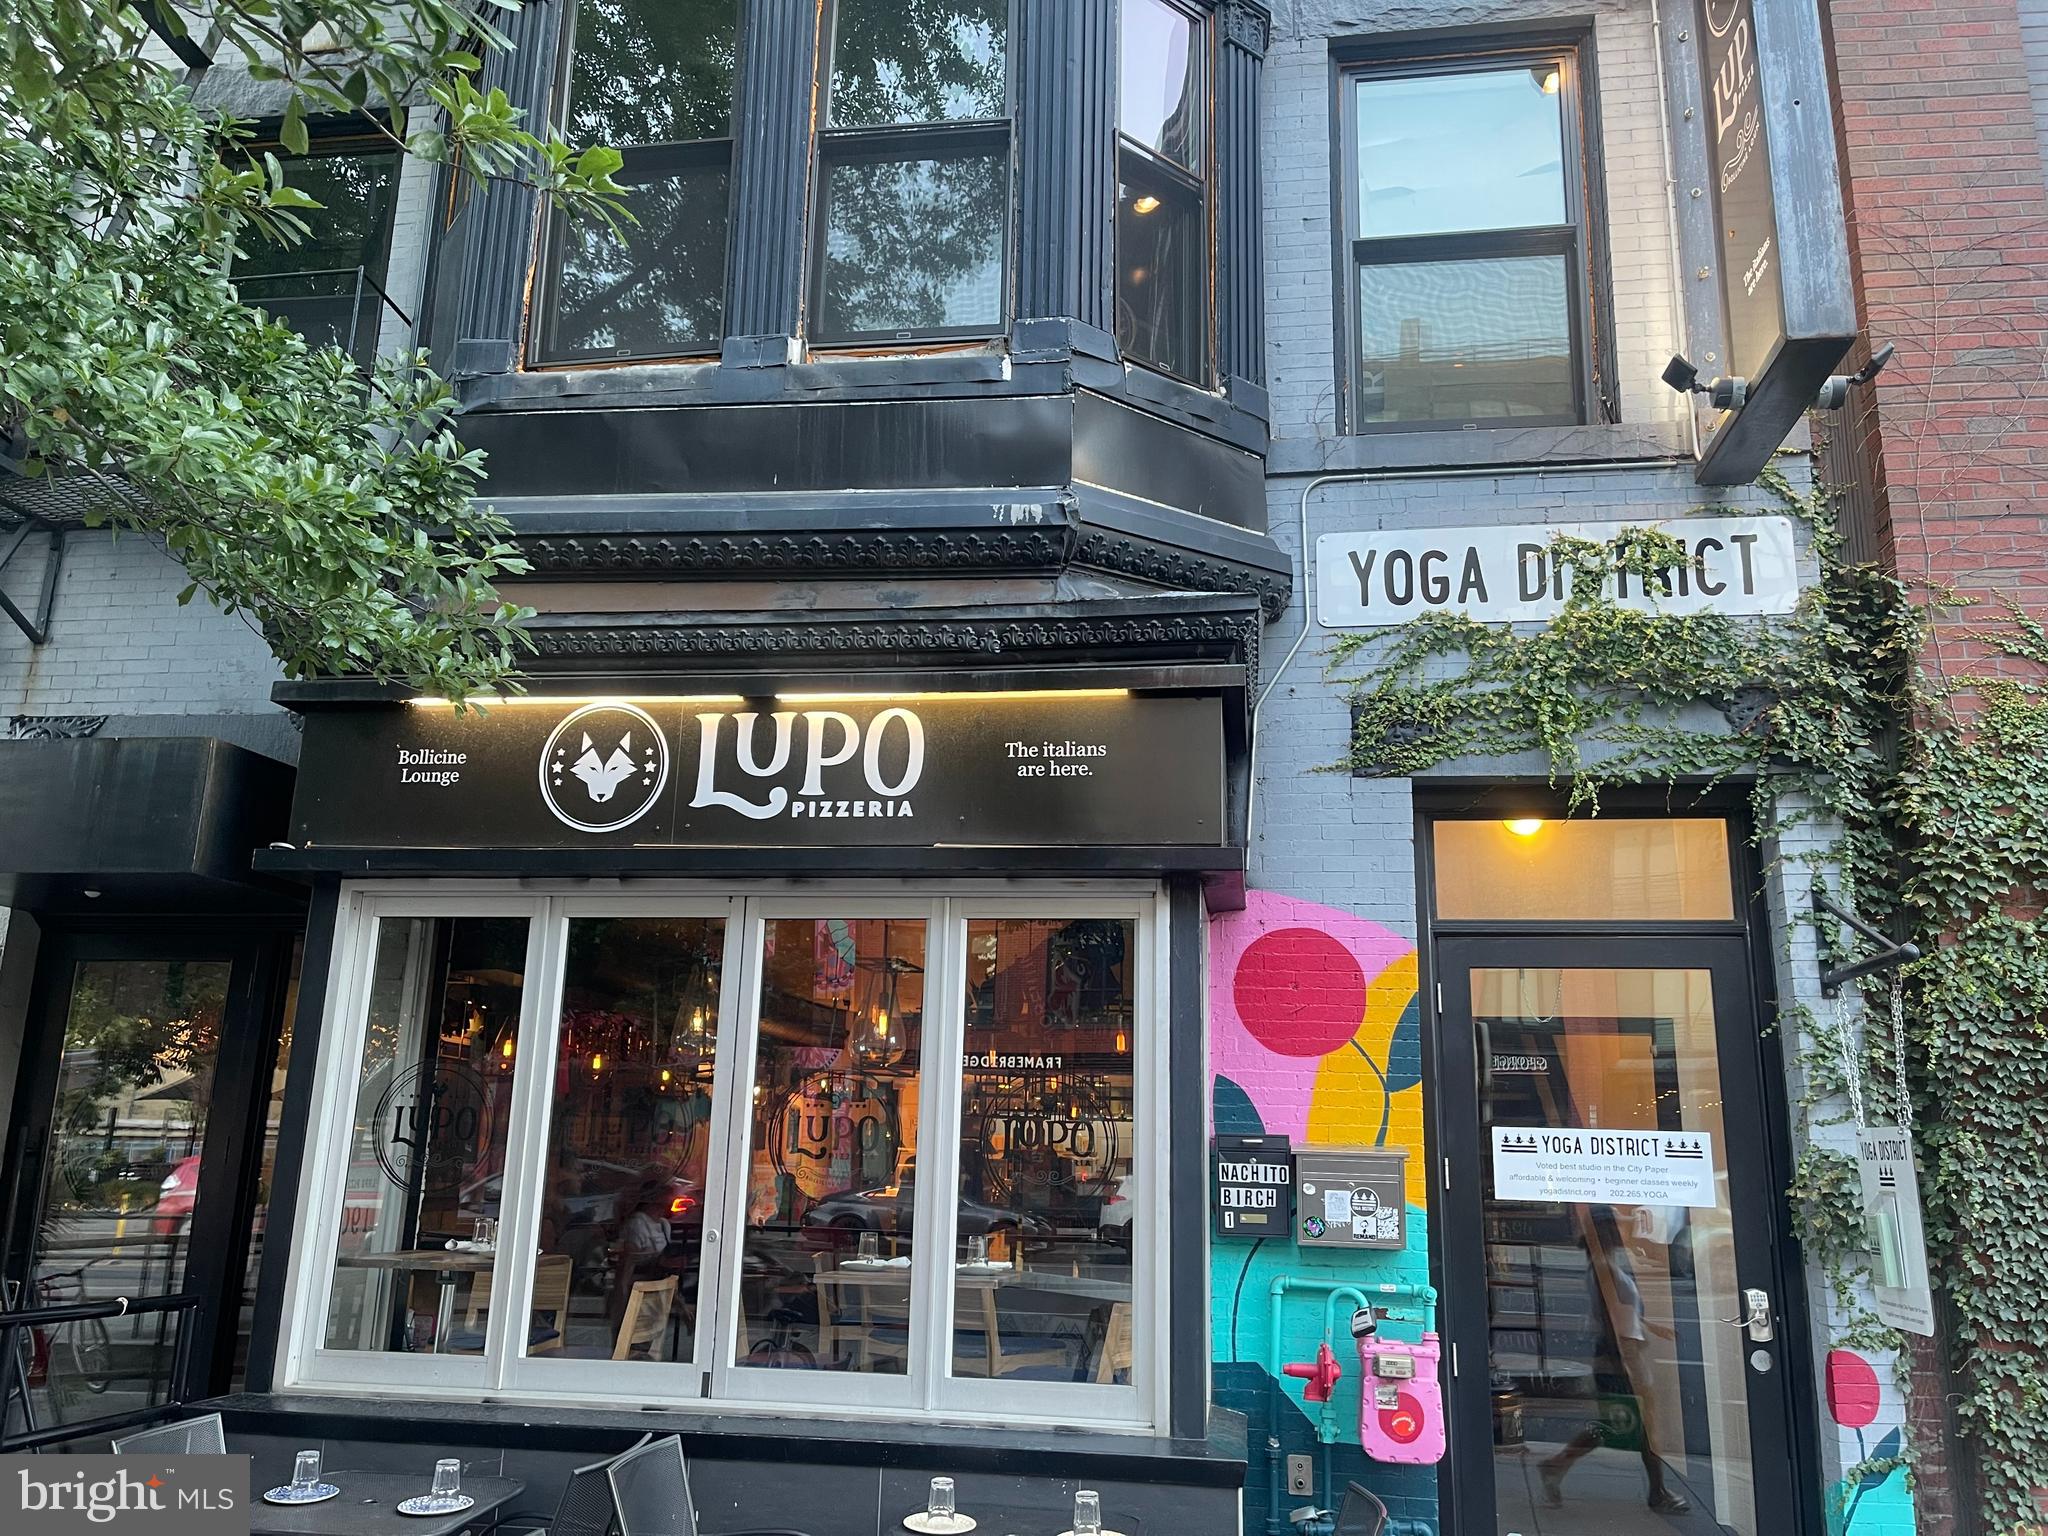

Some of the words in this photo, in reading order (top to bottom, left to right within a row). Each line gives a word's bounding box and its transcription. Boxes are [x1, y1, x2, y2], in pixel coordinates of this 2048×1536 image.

[1348, 546, 1489, 607] YOGA
[398, 748, 467, 765] Bollicine
[1005, 742, 1039, 758] The
[1042, 740, 1107, 757] italians
[688, 707, 925, 820] LUPO
[1017, 763, 1046, 777] are
[1049, 761, 1093, 777] here.
[400, 768, 460, 787] Lounge
[791, 801, 914, 818] PIZZERIA
[1542, 1135, 1583, 1154] YOGA
[1590, 1136, 1659, 1157] DISTRICT
[1860, 1141, 1878, 1160] YOGA
[1879, 1140, 1907, 1160] DISTRICT
[1221, 1164, 1287, 1183] NACHITO
[1536, 1162, 1558, 1170] Voted
[1560, 1162, 1576, 1170] best
[1579, 1163, 1601, 1171] studio
[1613, 1164, 1625, 1172] the
[1627, 1164, 1642, 1174] City
[1645, 1165, 1669, 1174] Paper
[1548, 1174, 1553, 1182] &
[1556, 1175, 1596, 1184] welcoming
[1605, 1177, 1639, 1186] beginner
[1640, 1178, 1669, 1186] classes
[1672, 1179, 1698, 1188] weekly
[1223, 1189, 1275, 1207] BIRCH
[1227, 1213, 1233, 1226] 1
